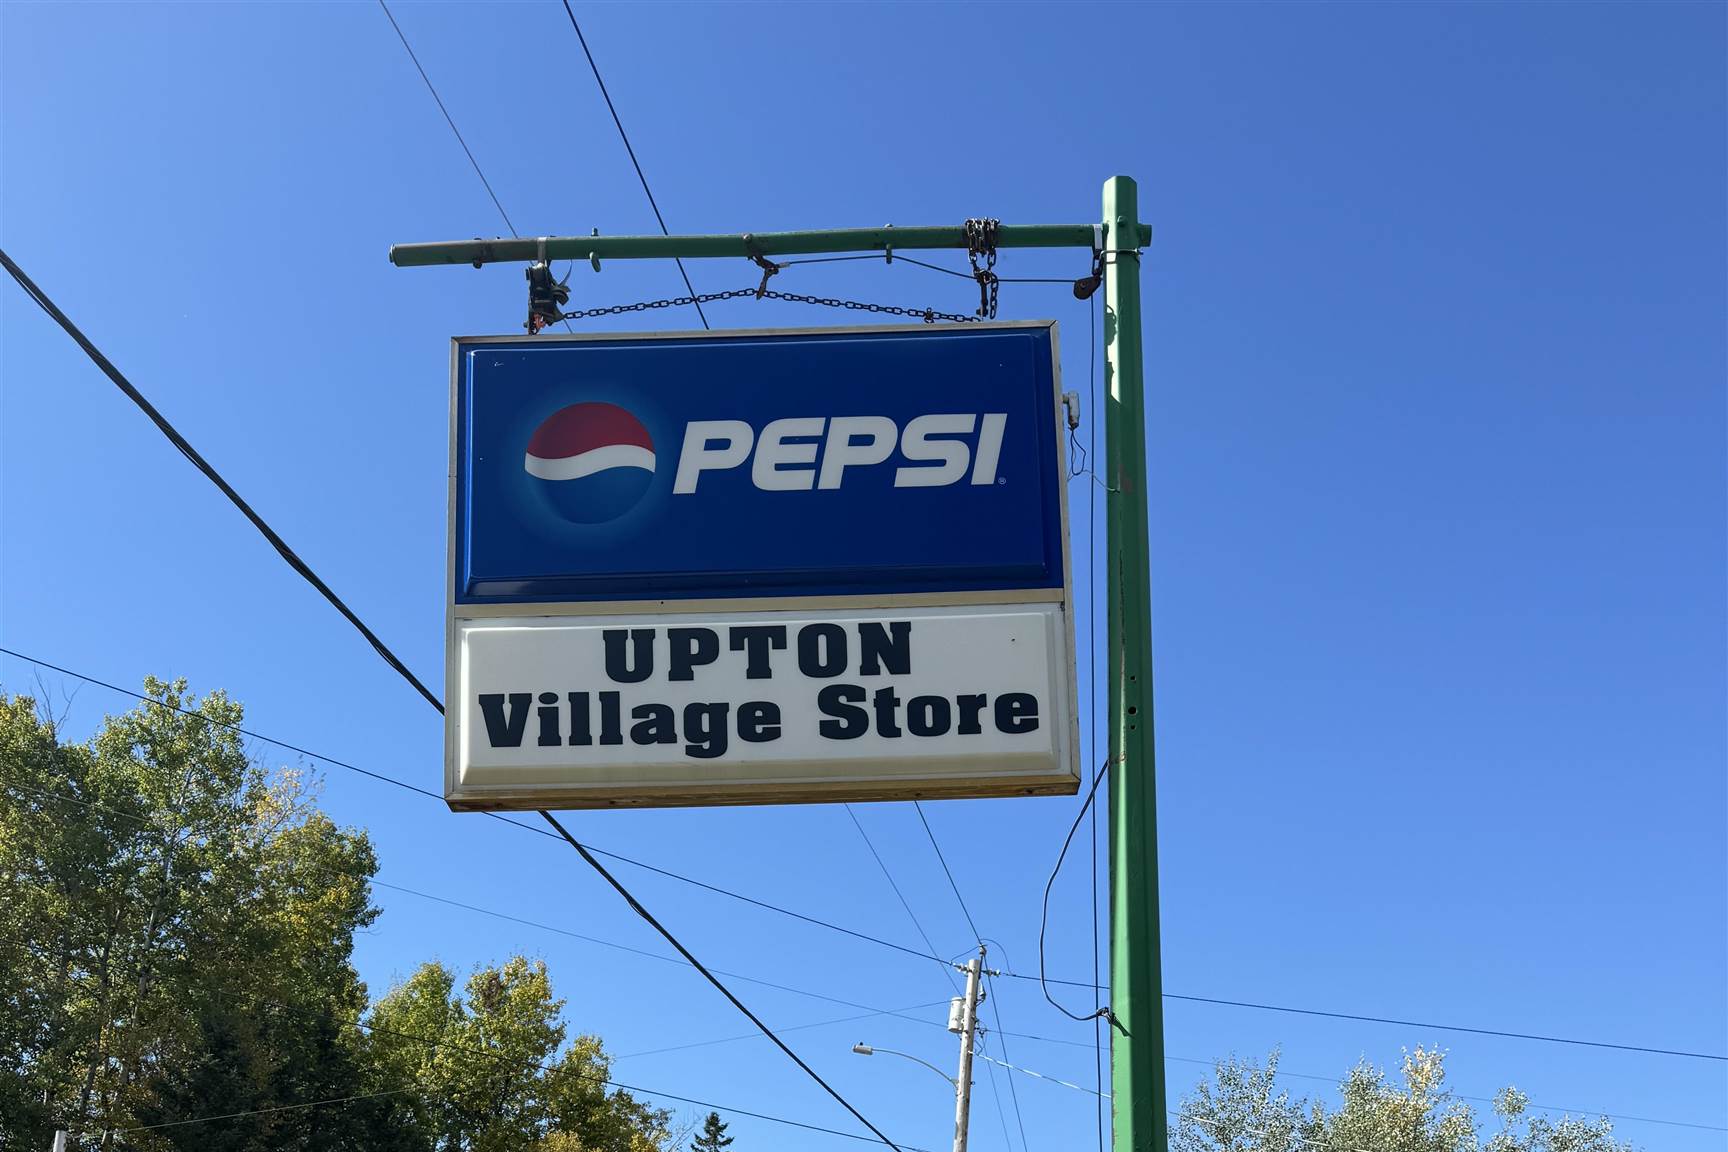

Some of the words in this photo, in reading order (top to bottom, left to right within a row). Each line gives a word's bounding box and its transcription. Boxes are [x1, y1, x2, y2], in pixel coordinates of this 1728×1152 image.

[673, 414, 1008, 493] PEPSI
[603, 621, 911, 683] UPTON
[479, 691, 782, 758] Village
[818, 684, 1039, 740] Store
